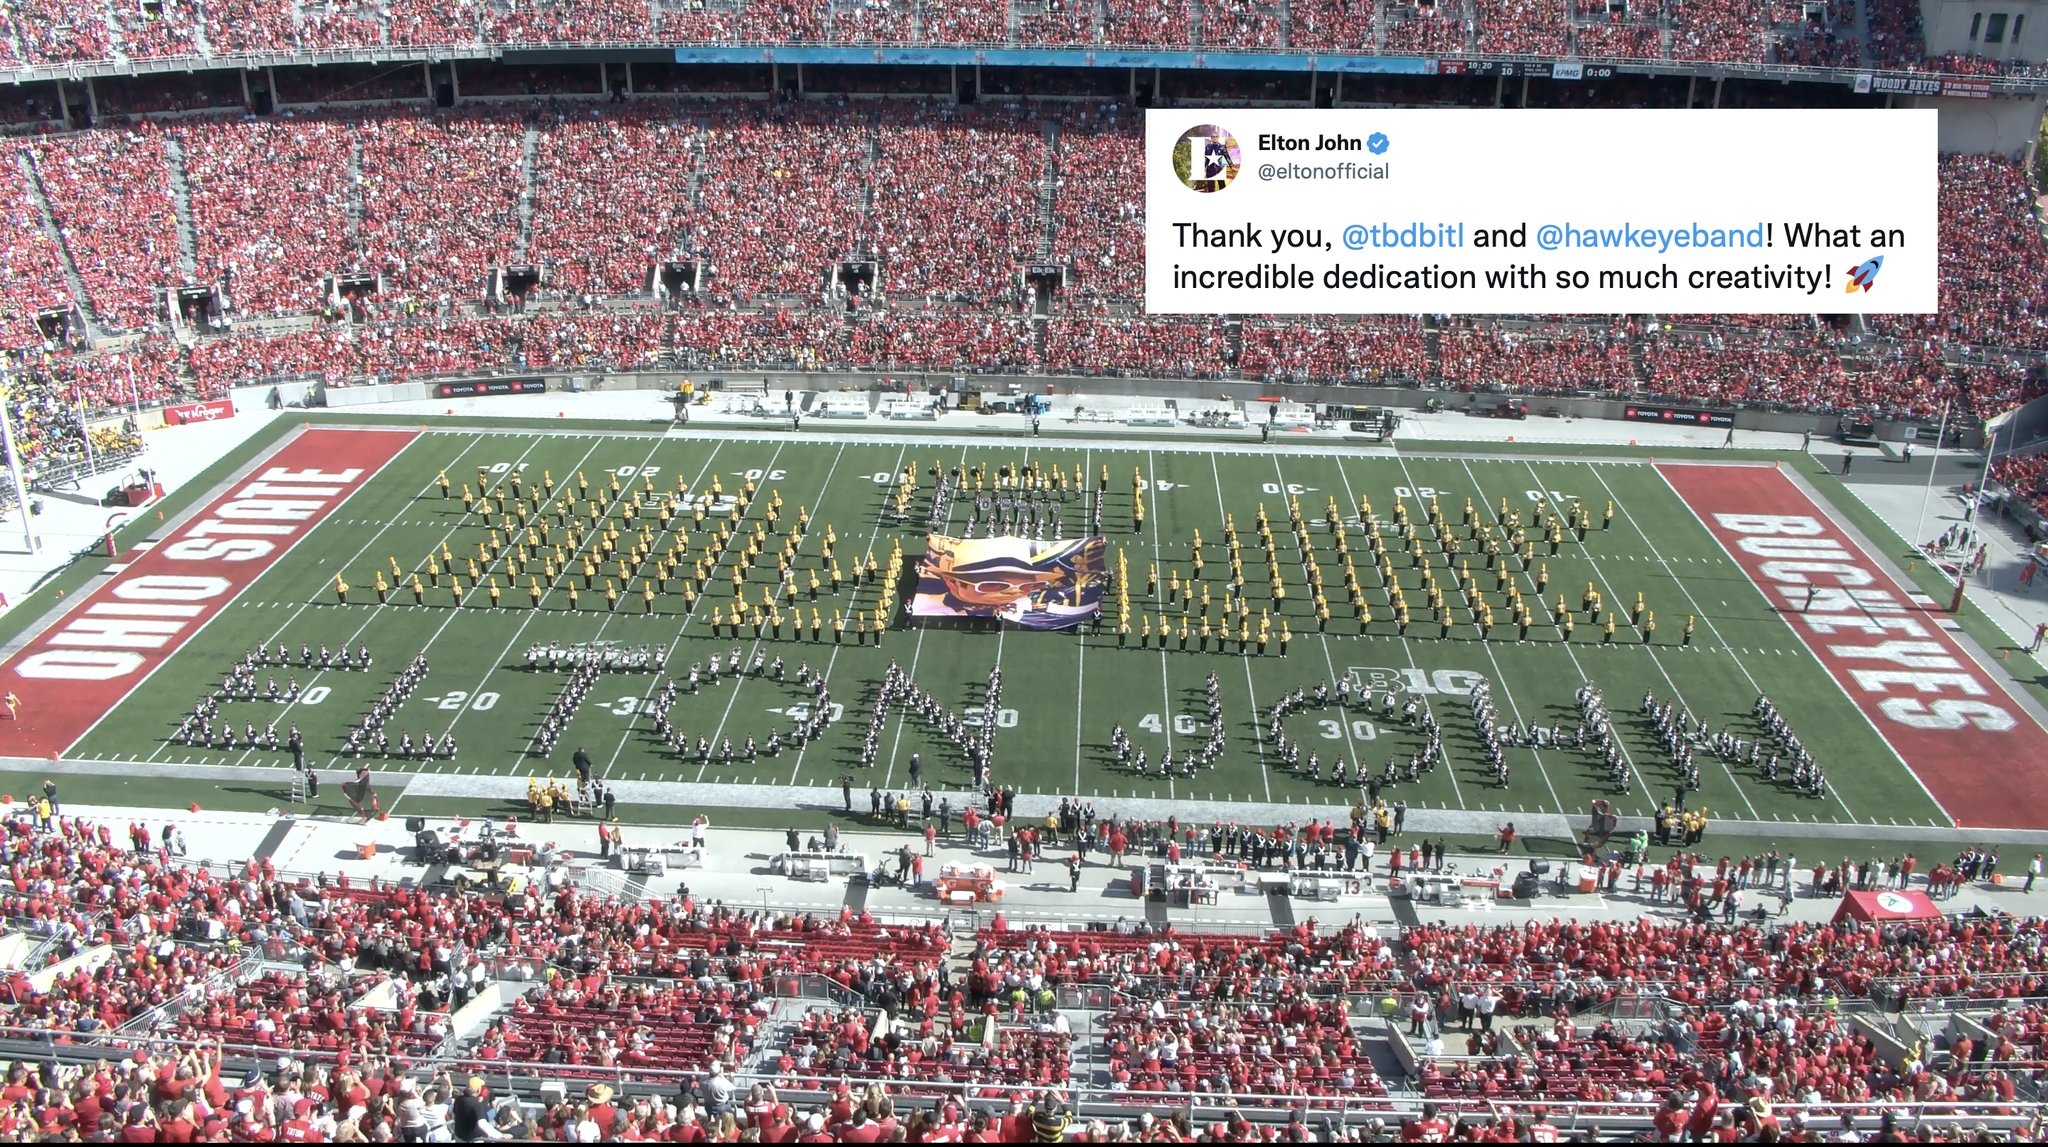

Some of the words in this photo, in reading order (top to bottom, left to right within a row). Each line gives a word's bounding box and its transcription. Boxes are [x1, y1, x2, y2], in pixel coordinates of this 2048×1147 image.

[1446, 66, 1457, 74] 26
[1468, 62, 1492, 70] 10:20
[1501, 68, 1513, 76] 10
[1554, 69, 1579, 78] KPMG
[1587, 68, 1611, 77] 0:00
[1873, 77, 1908, 90] WOODY
[1909, 79, 1940, 92] HAYES
[191, 404, 225, 420] Kroger
[616, 466, 660, 477] 20
[1262, 483, 1305, 495] 30
[1393, 486, 1436, 498] 20
[14, 574, 233, 681] OHIO
[161, 466, 367, 562] STATE
[1711, 512, 2019, 732] BUCKEYES
[437, 691, 501, 711] 20
[963, 708, 1019, 728] 50
[1138, 713, 1196, 735] 40
[1317, 719, 1377, 741] 30
[1344, 880, 1361, 895] 13
